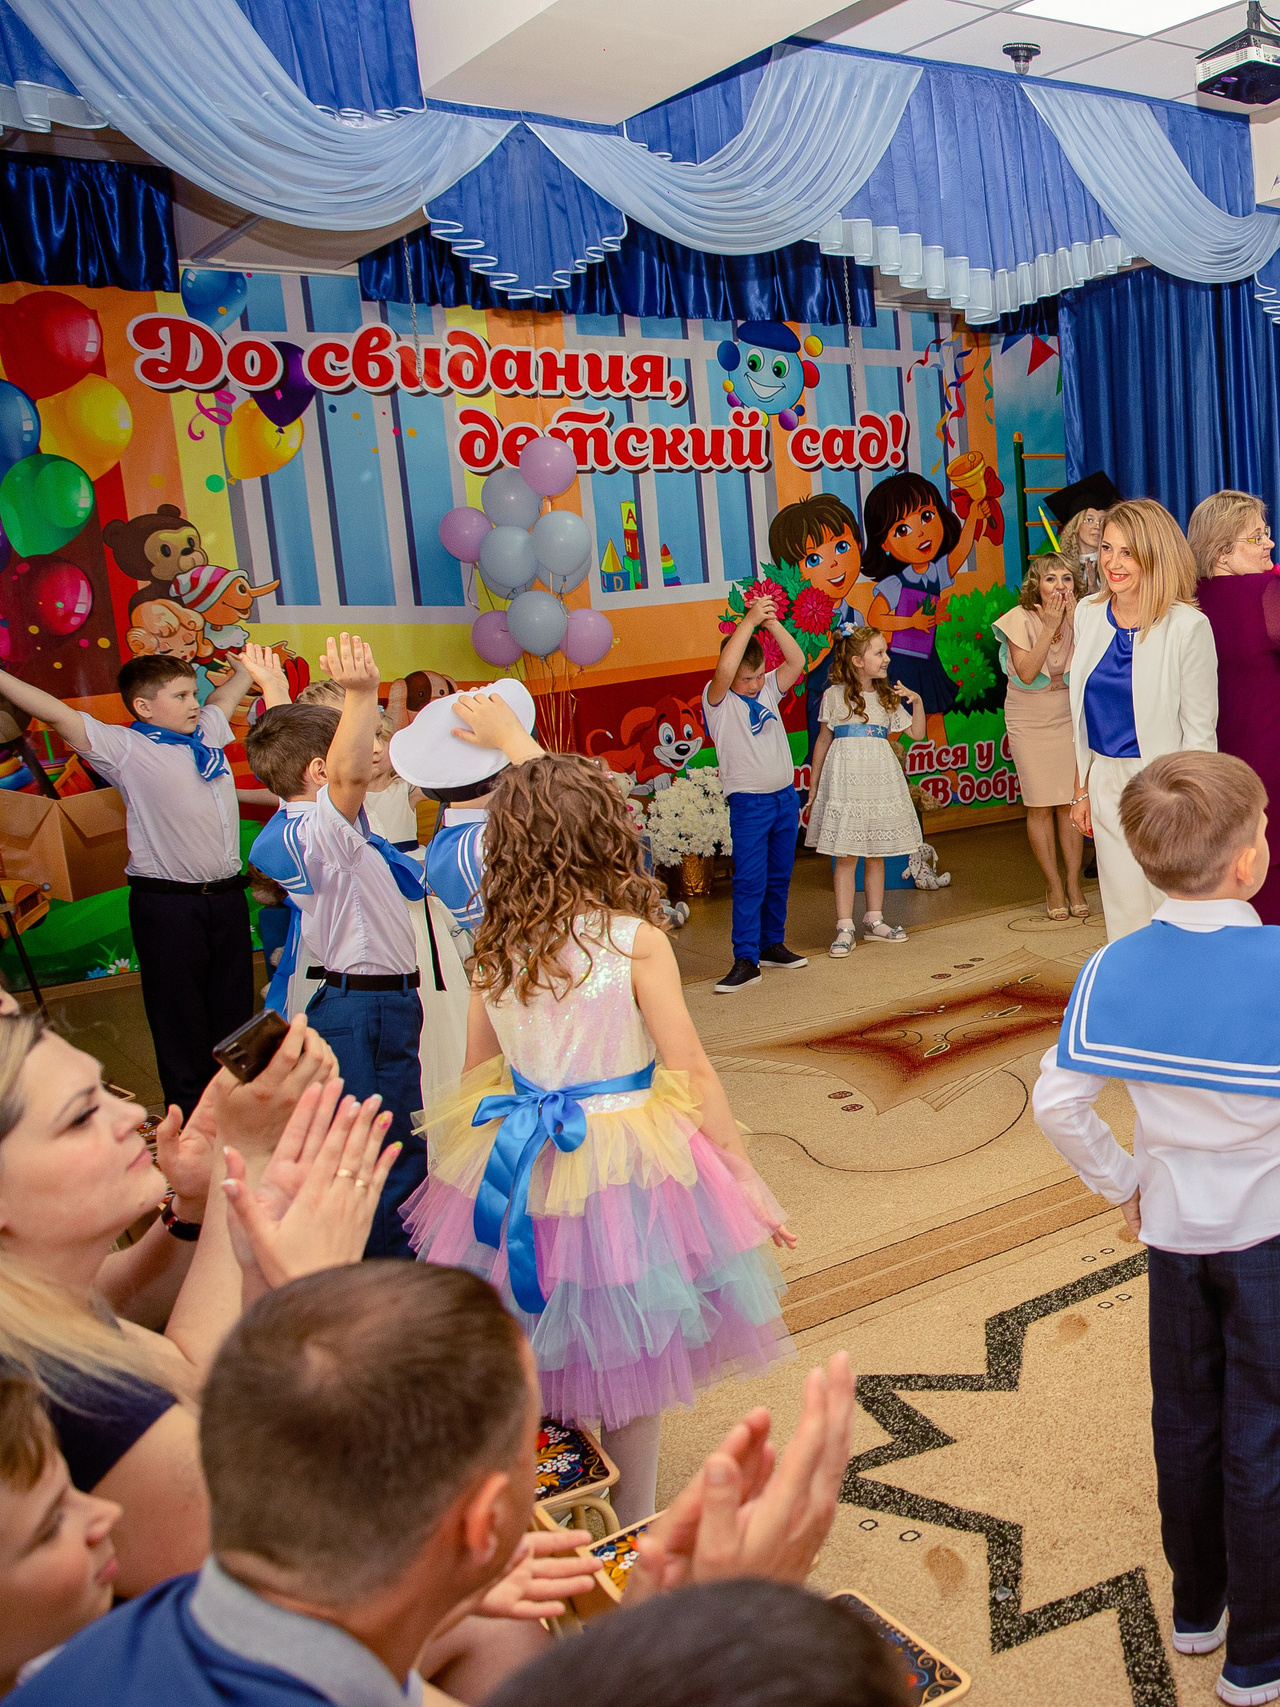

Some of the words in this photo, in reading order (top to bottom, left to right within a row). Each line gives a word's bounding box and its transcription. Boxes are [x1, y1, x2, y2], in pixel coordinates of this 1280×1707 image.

[129, 314, 282, 390] До
[303, 322, 686, 405] свидания,
[456, 406, 769, 471] детский
[789, 410, 907, 470] сад!
[958, 766, 1021, 804] добр
